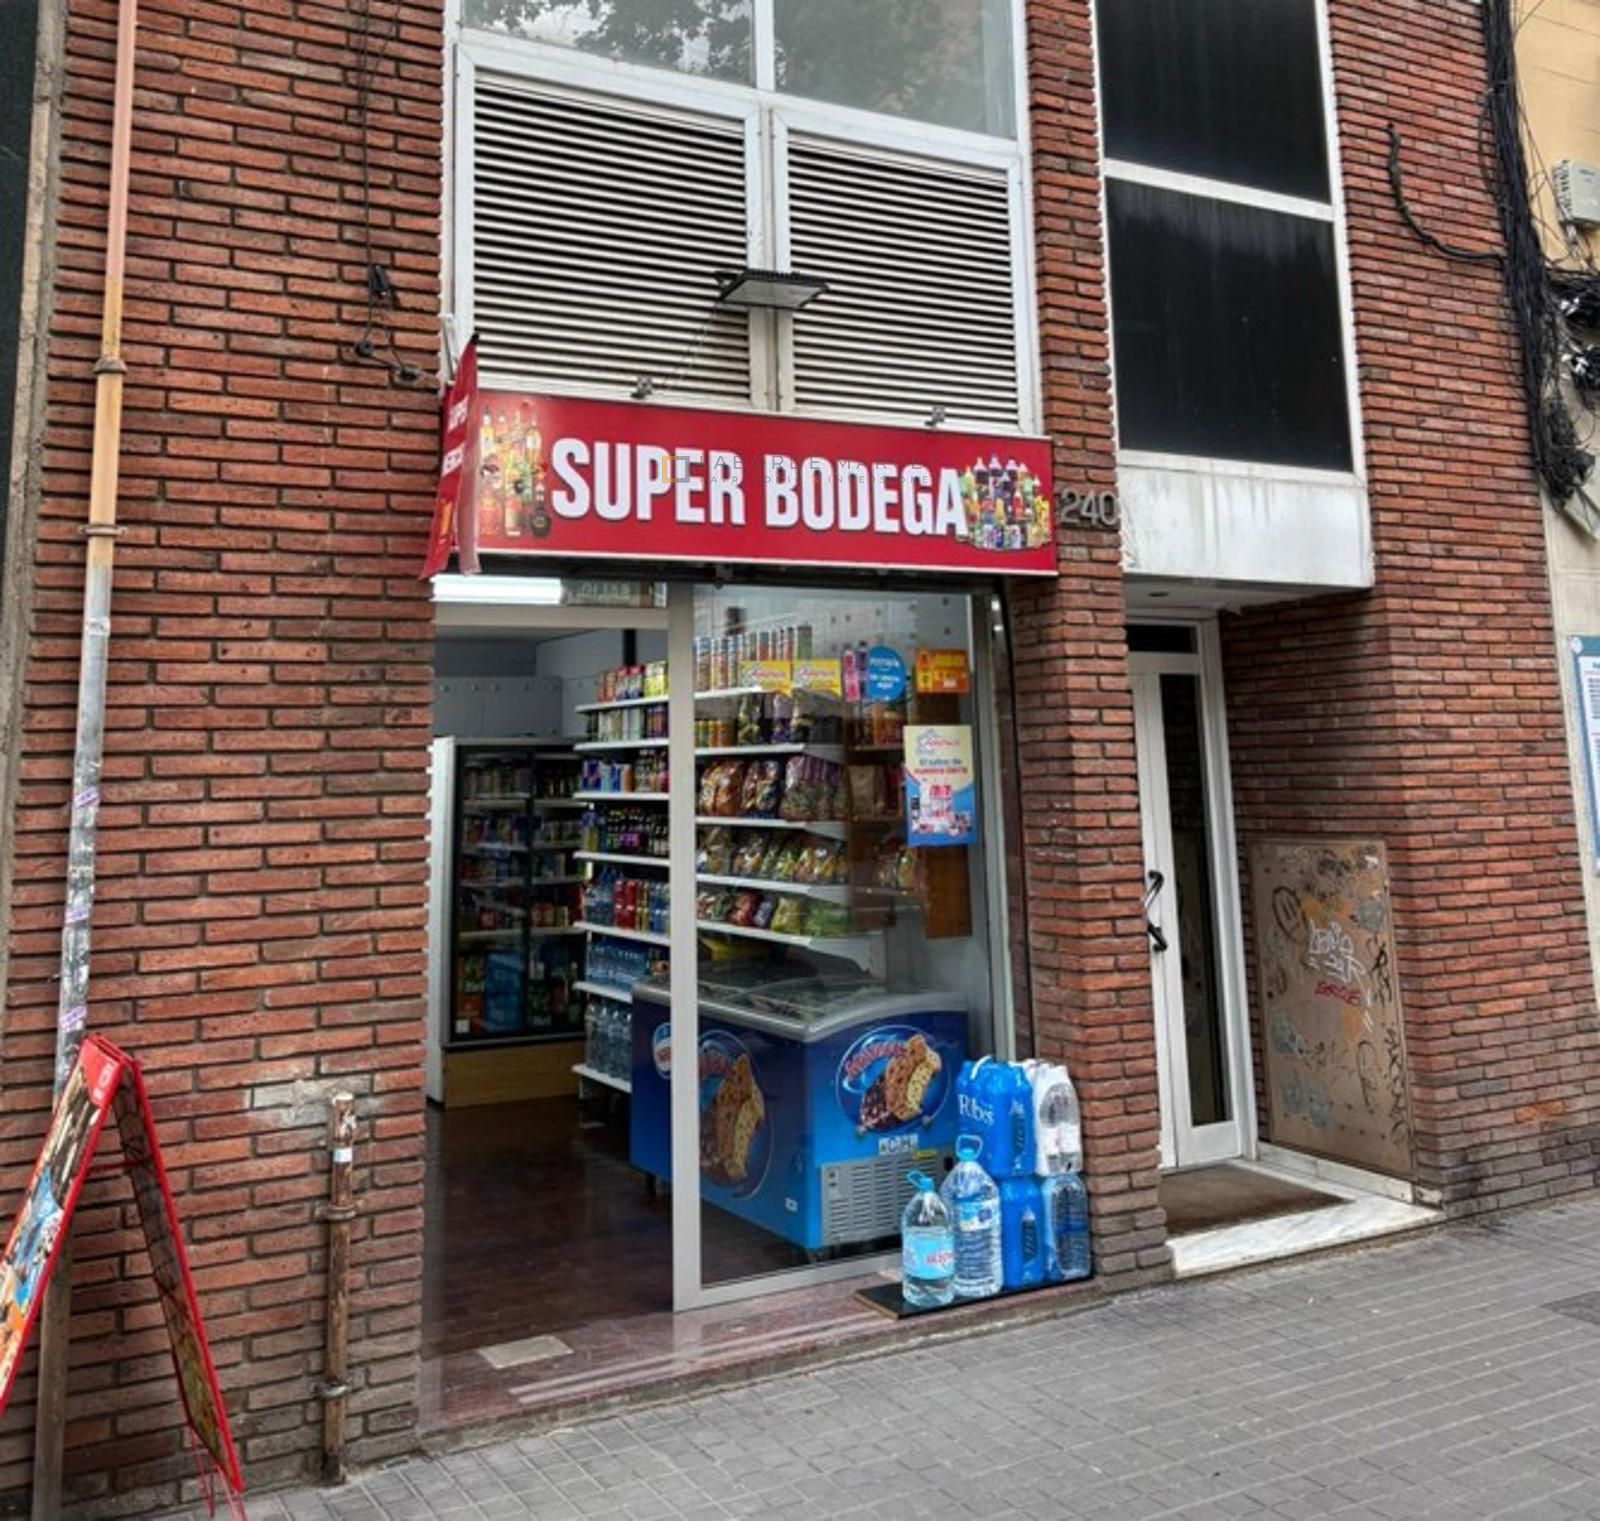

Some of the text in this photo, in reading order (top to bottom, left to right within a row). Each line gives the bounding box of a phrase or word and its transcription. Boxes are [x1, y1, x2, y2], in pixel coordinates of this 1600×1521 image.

[551, 437, 746, 526] SUPER
[763, 453, 969, 537] BODEGA
[1059, 488, 1121, 526] 240
